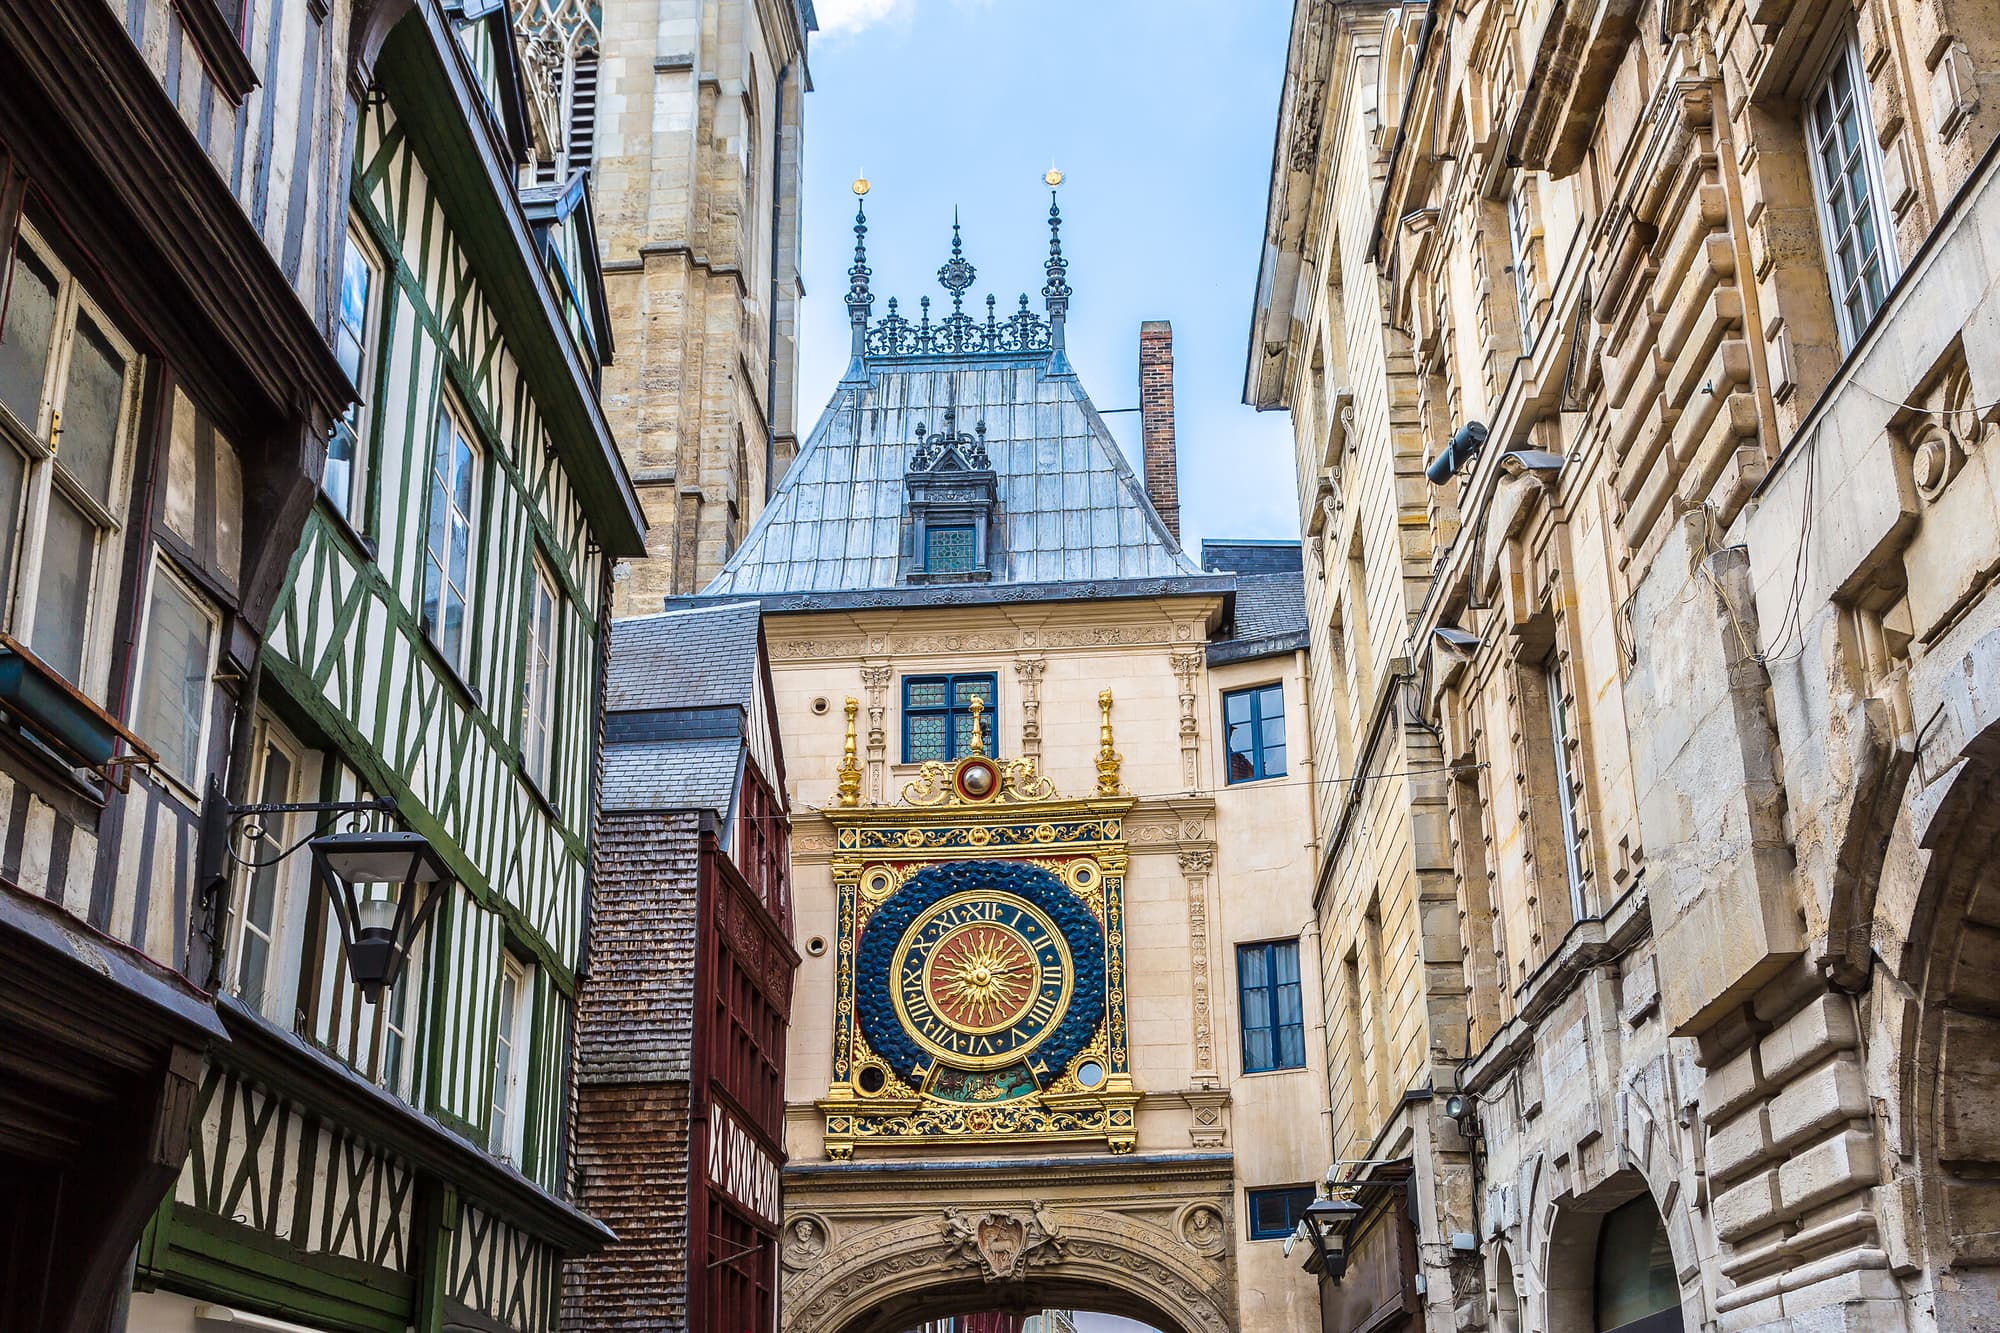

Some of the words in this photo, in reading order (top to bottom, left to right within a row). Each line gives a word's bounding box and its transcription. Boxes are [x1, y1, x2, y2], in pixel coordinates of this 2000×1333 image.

[965, 902, 998, 921] XII
[1010, 911, 1023, 927] I
[931, 909, 961, 935] XI
[911, 936, 932, 955] X
[1032, 934, 1053, 952] II
[903, 968, 922, 992] IX
[1043, 966, 1062, 986] III
[1028, 996, 1056, 1025] IIII
[930, 1024, 959, 1052] VII
[968, 1036, 994, 1055] VI
[1012, 1028, 1030, 1047] V
